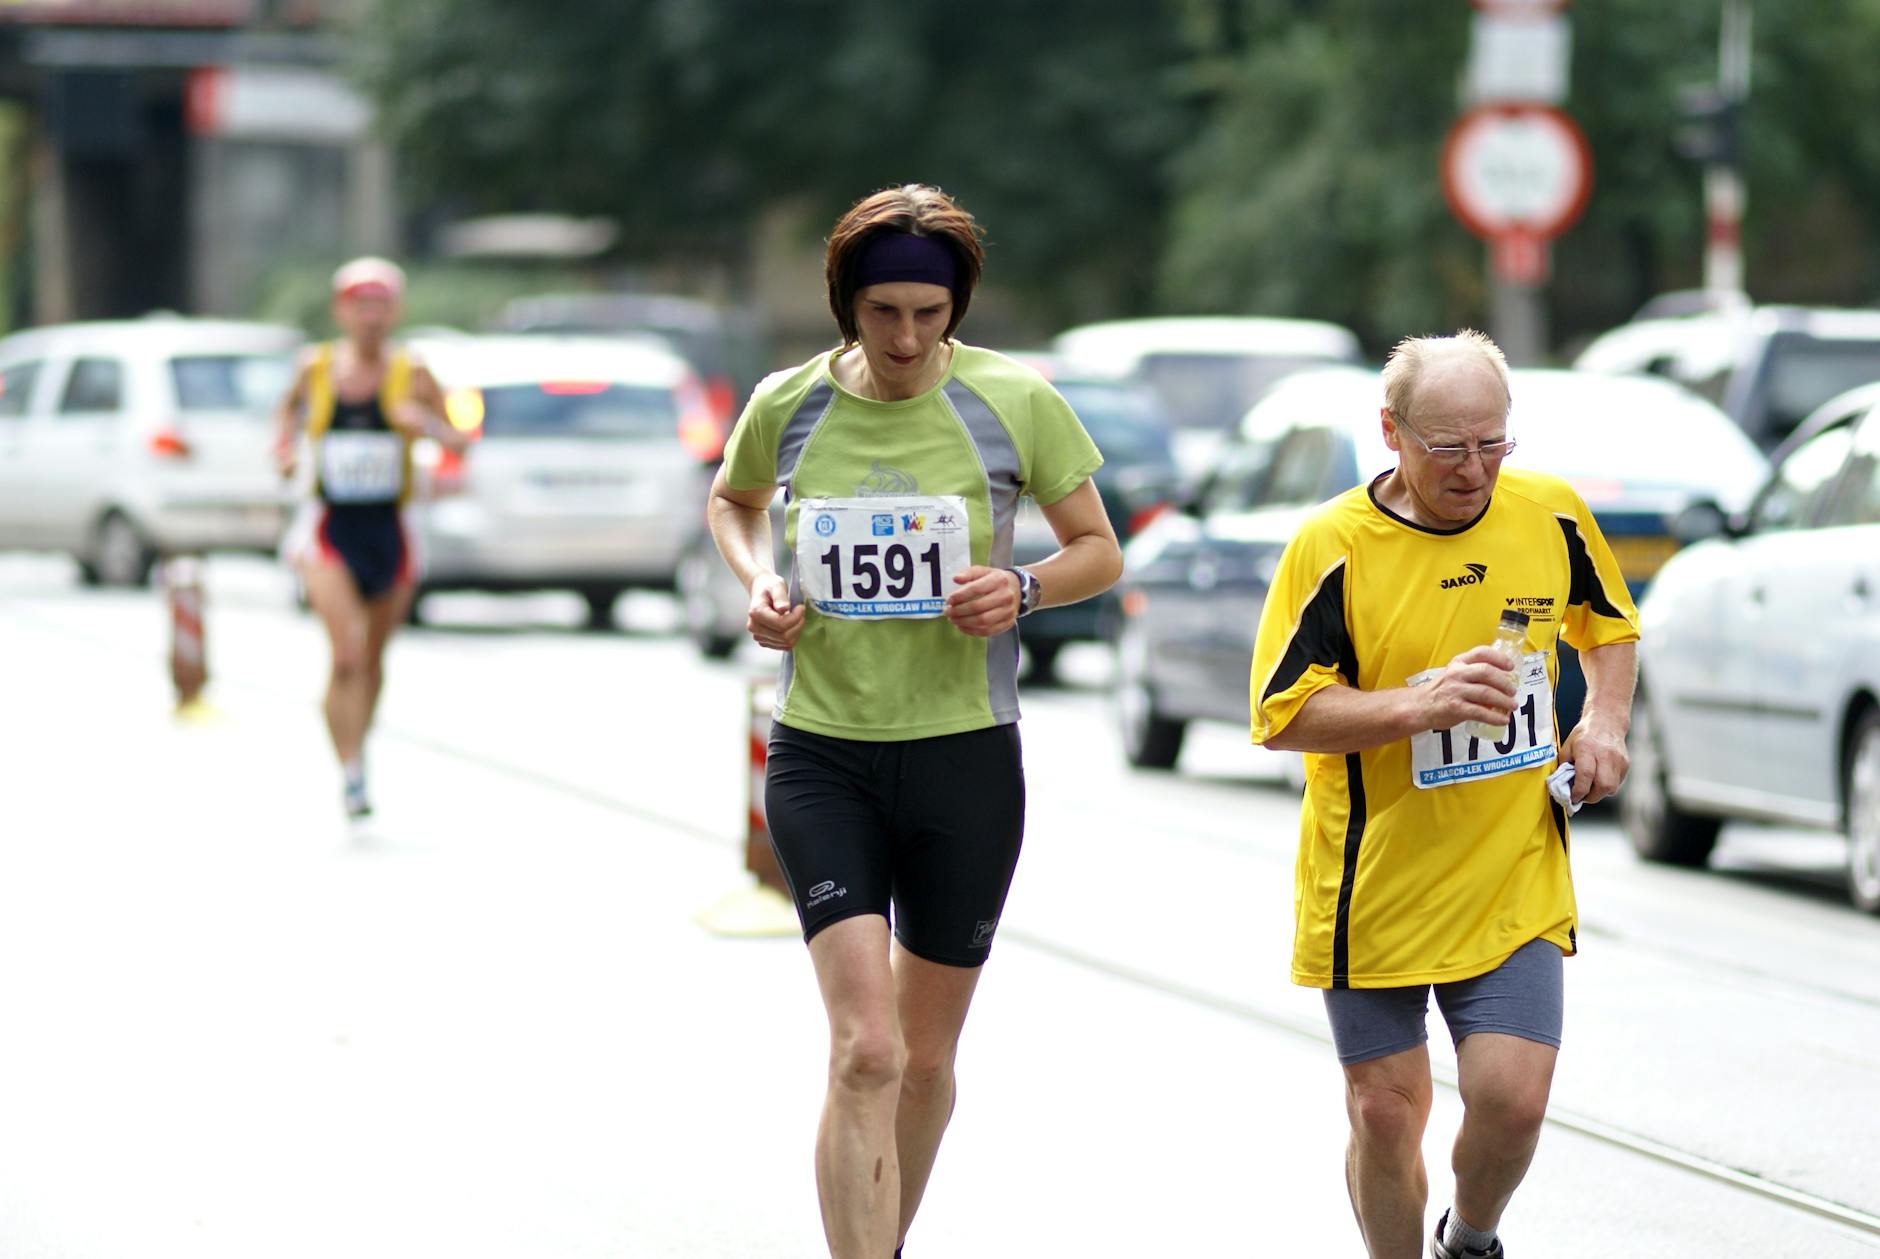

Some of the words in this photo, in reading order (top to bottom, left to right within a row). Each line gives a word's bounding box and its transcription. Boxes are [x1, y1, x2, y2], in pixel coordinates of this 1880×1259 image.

[821, 543, 942, 599] 1591
[1440, 574, 1476, 589] JAKO
[1432, 694, 1538, 765] 11
[1483, 755, 1522, 772] WROCŁAW
